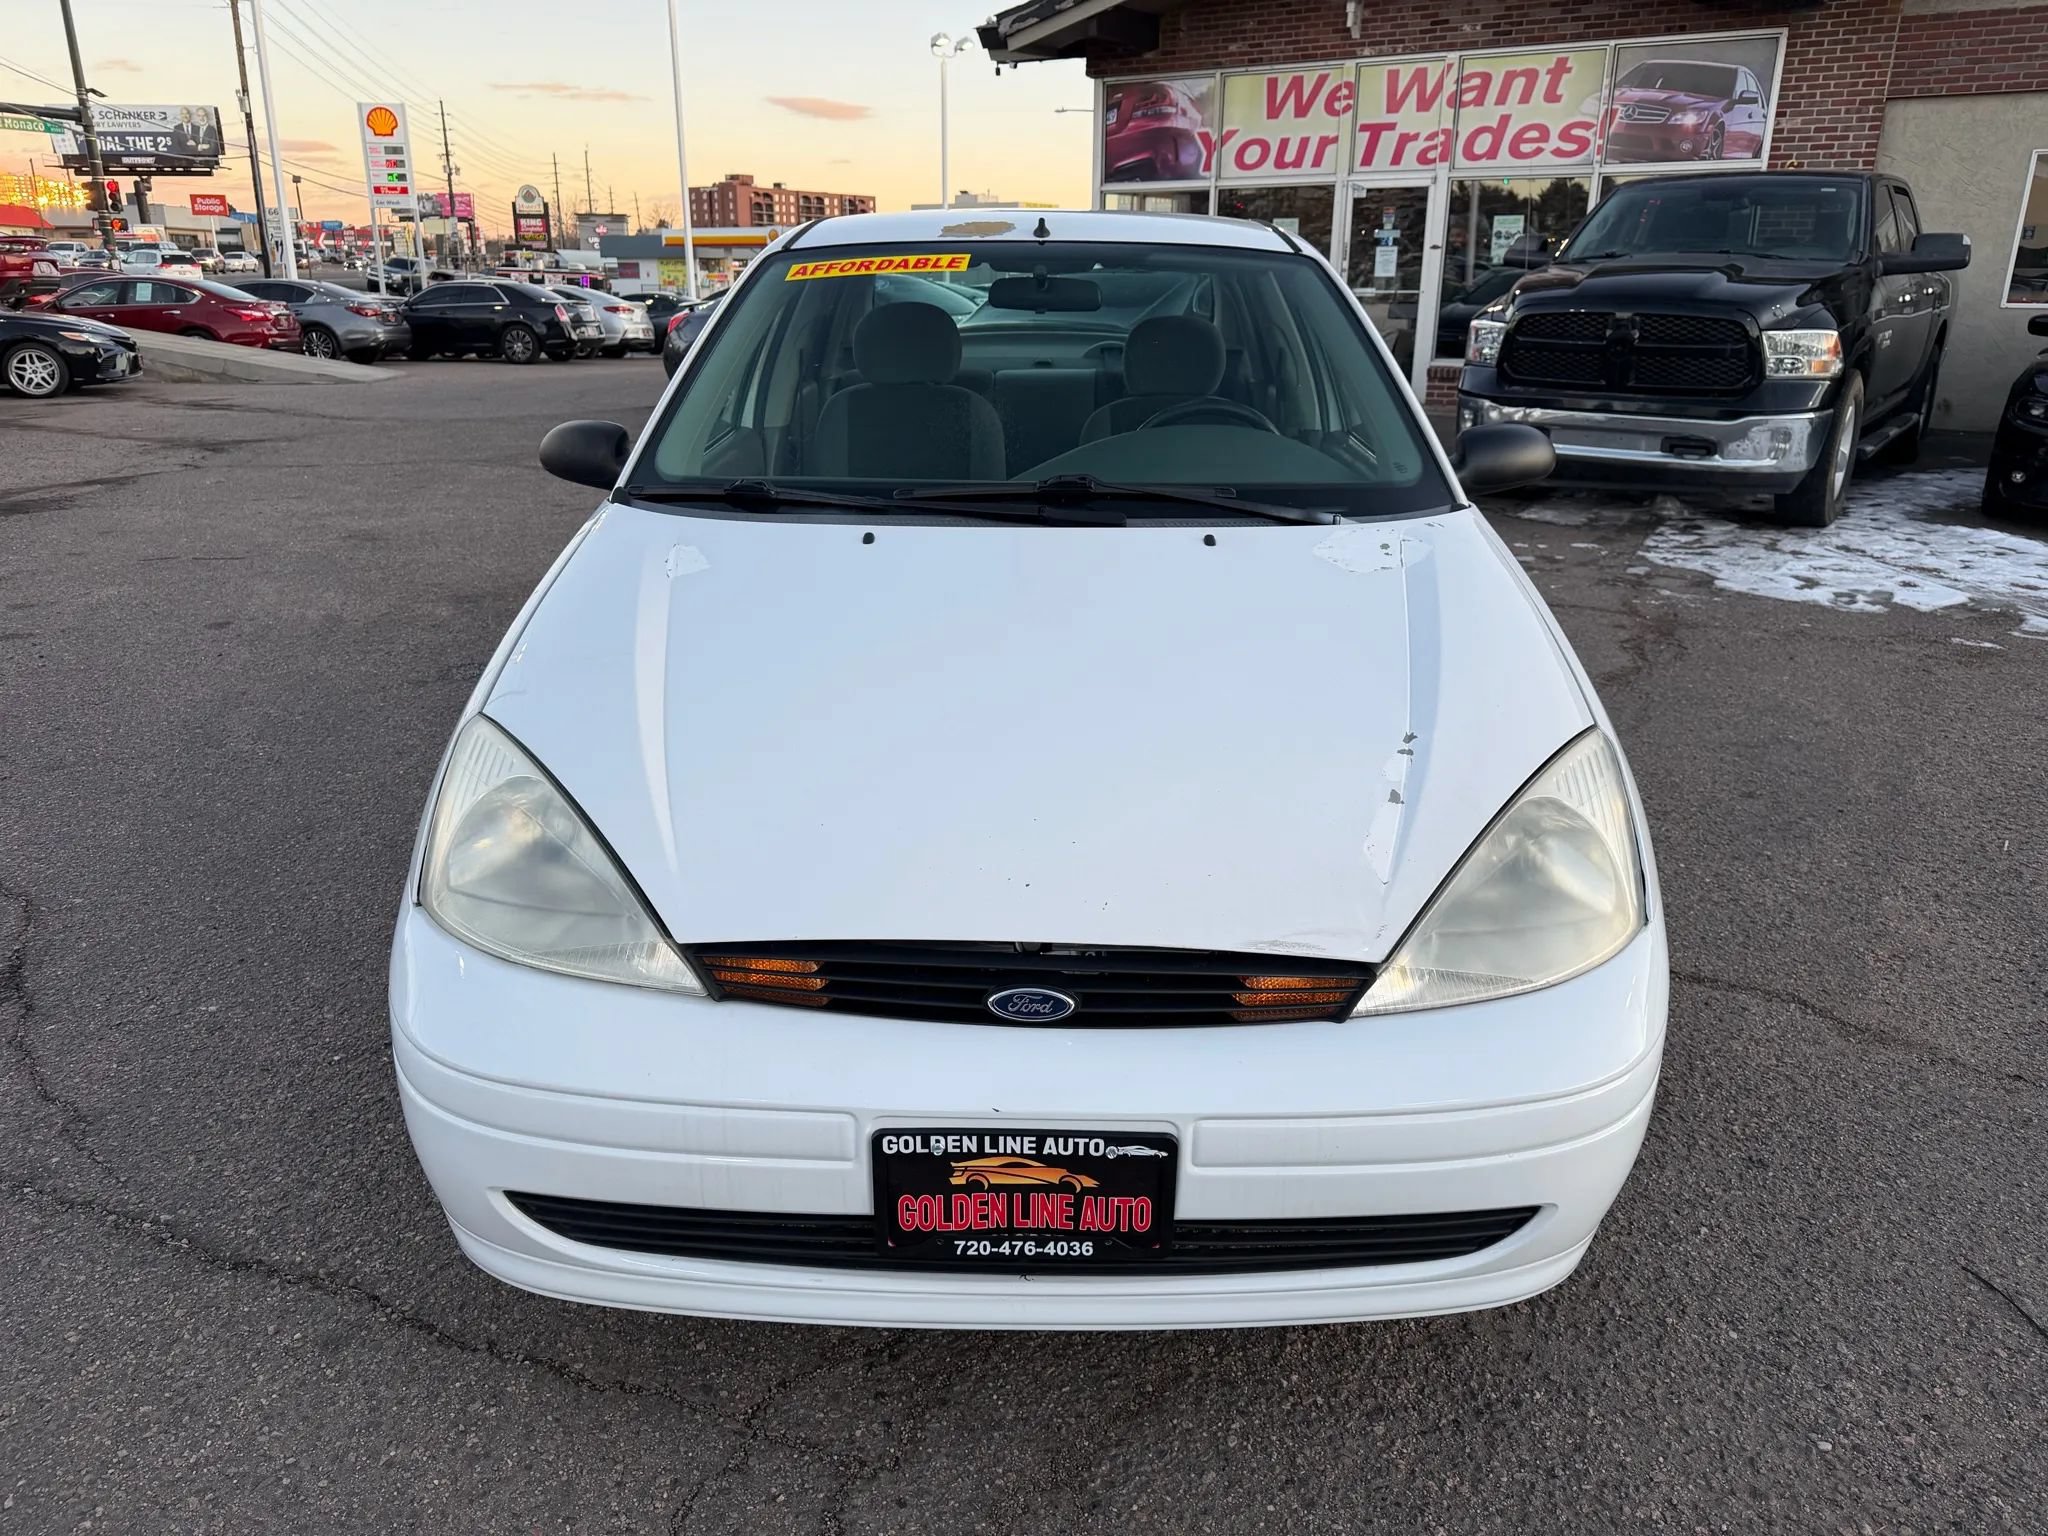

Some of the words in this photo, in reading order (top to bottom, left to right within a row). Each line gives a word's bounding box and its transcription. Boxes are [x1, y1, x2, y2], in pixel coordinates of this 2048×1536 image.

[1266, 73, 1356, 120] We
[1385, 56, 1573, 114] Want
[4, 118, 45, 131] Monaco
[99, 110, 156, 120] SCHANKER
[125, 136, 155, 151] THE
[1196, 128, 1339, 172] Your
[1358, 108, 1620, 167] Trades!
[194, 204, 224, 212] Storage
[790, 256, 967, 277] AFFORDABLE
[1008, 994, 1054, 1013] Ford
[882, 1135, 977, 1155] GOLDEN
[984, 1136, 1037, 1155] LINE
[1042, 1137, 1105, 1156] AUTO
[898, 1193, 1007, 1232] GOLDEN
[1013, 1193, 1074, 1230] LINE
[1080, 1196, 1152, 1232] AUTO
[954, 1240, 1094, 1256] 720-476-4036
